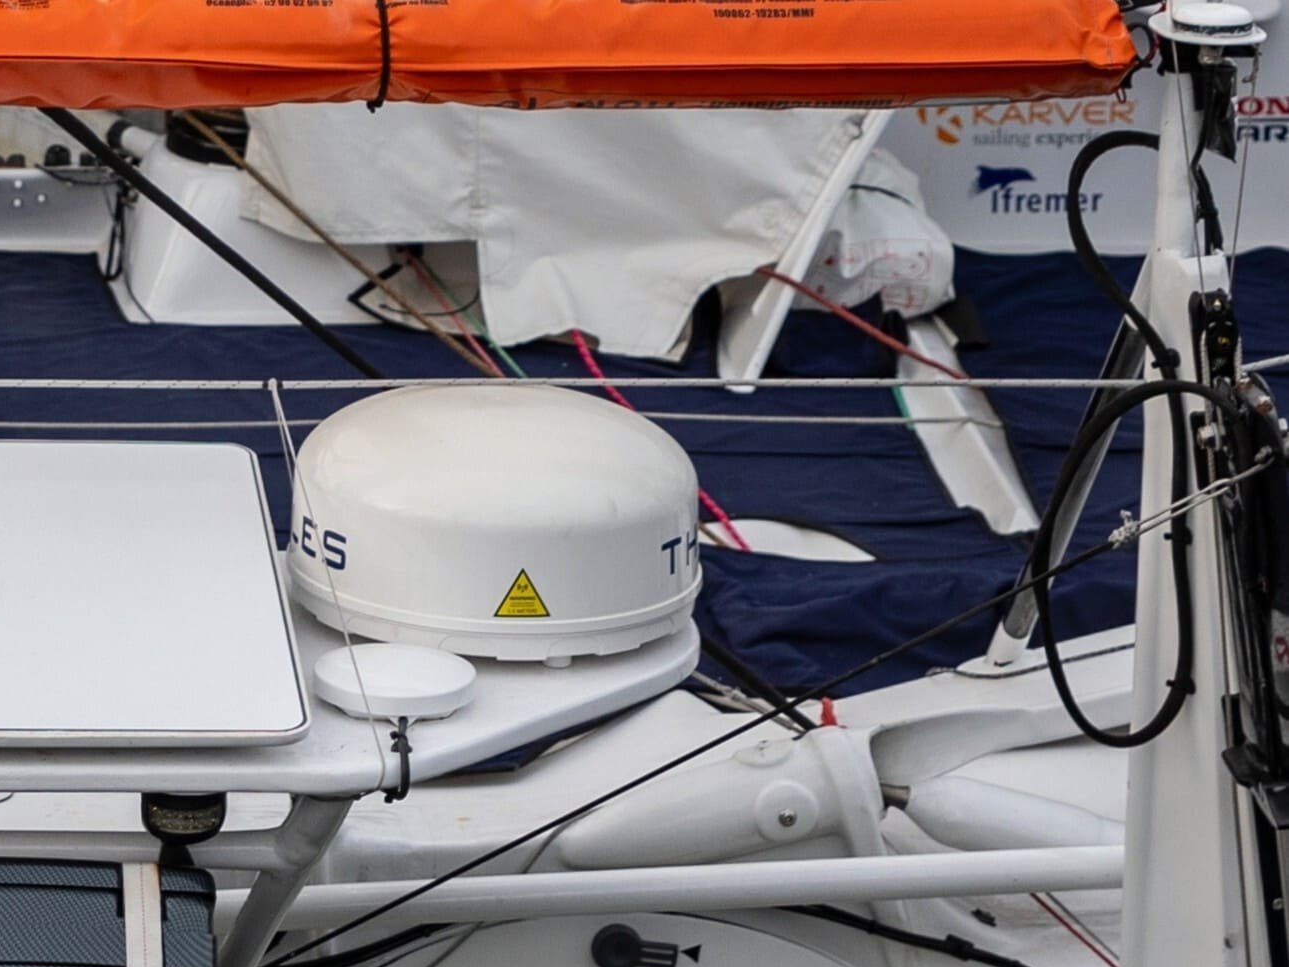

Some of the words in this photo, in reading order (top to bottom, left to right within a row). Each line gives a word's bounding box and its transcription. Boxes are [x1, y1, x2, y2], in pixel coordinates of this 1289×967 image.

[972, 101, 1135, 126] KARVER
[972, 127, 1031, 148] sailing
[1035, 128, 1096, 149] experi
